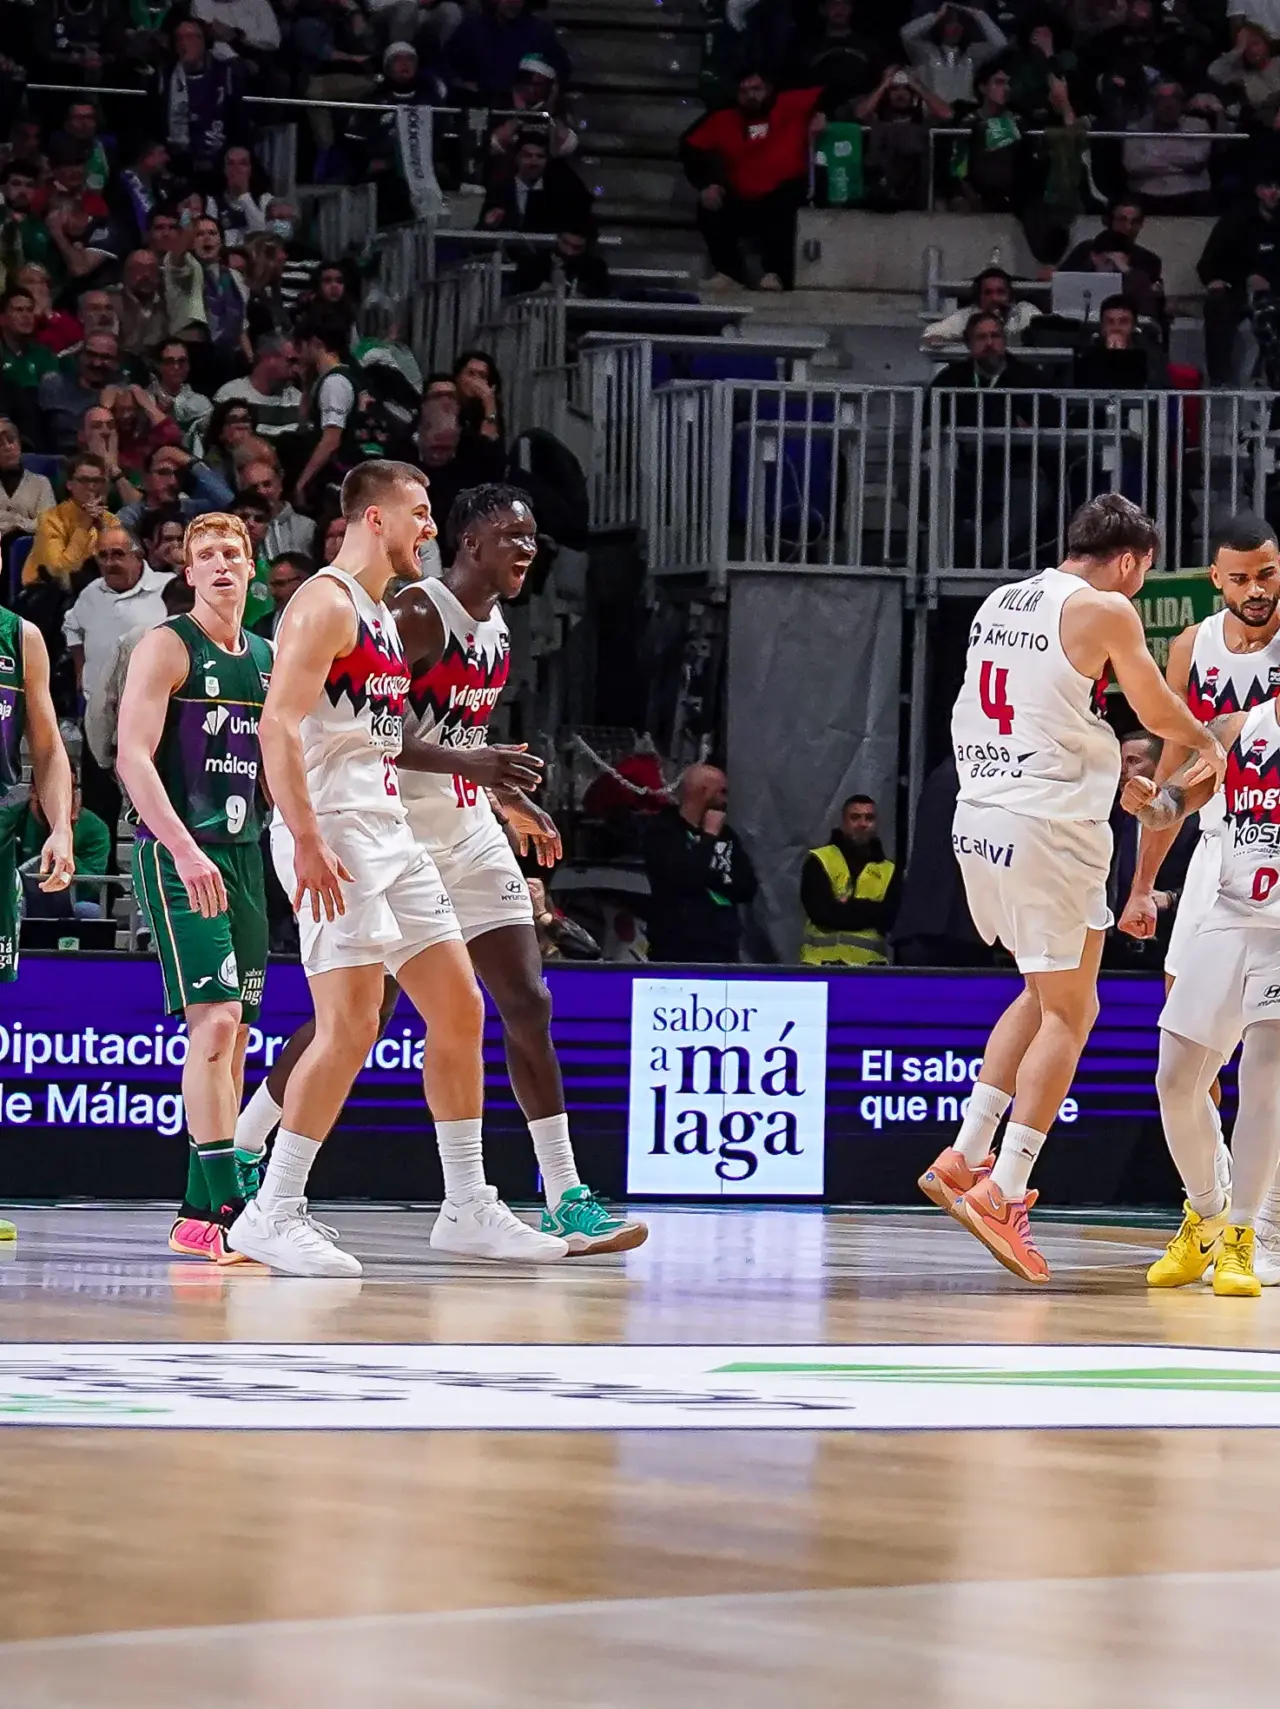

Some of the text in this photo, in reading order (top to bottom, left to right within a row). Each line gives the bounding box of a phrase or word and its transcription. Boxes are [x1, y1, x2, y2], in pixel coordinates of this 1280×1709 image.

[998, 589, 1044, 612] VILLAR
[1132, 596, 1195, 628] LIDA
[984, 628, 1049, 652] AMUTIO
[979, 660, 1015, 735] 4
[225, 795, 247, 834] 9
[652, 993, 758, 1033] sabor
[650, 1021, 807, 1097] a má
[860, 1050, 892, 1082] El
[860, 1097, 928, 1130] que
[647, 1084, 805, 1181] laga
